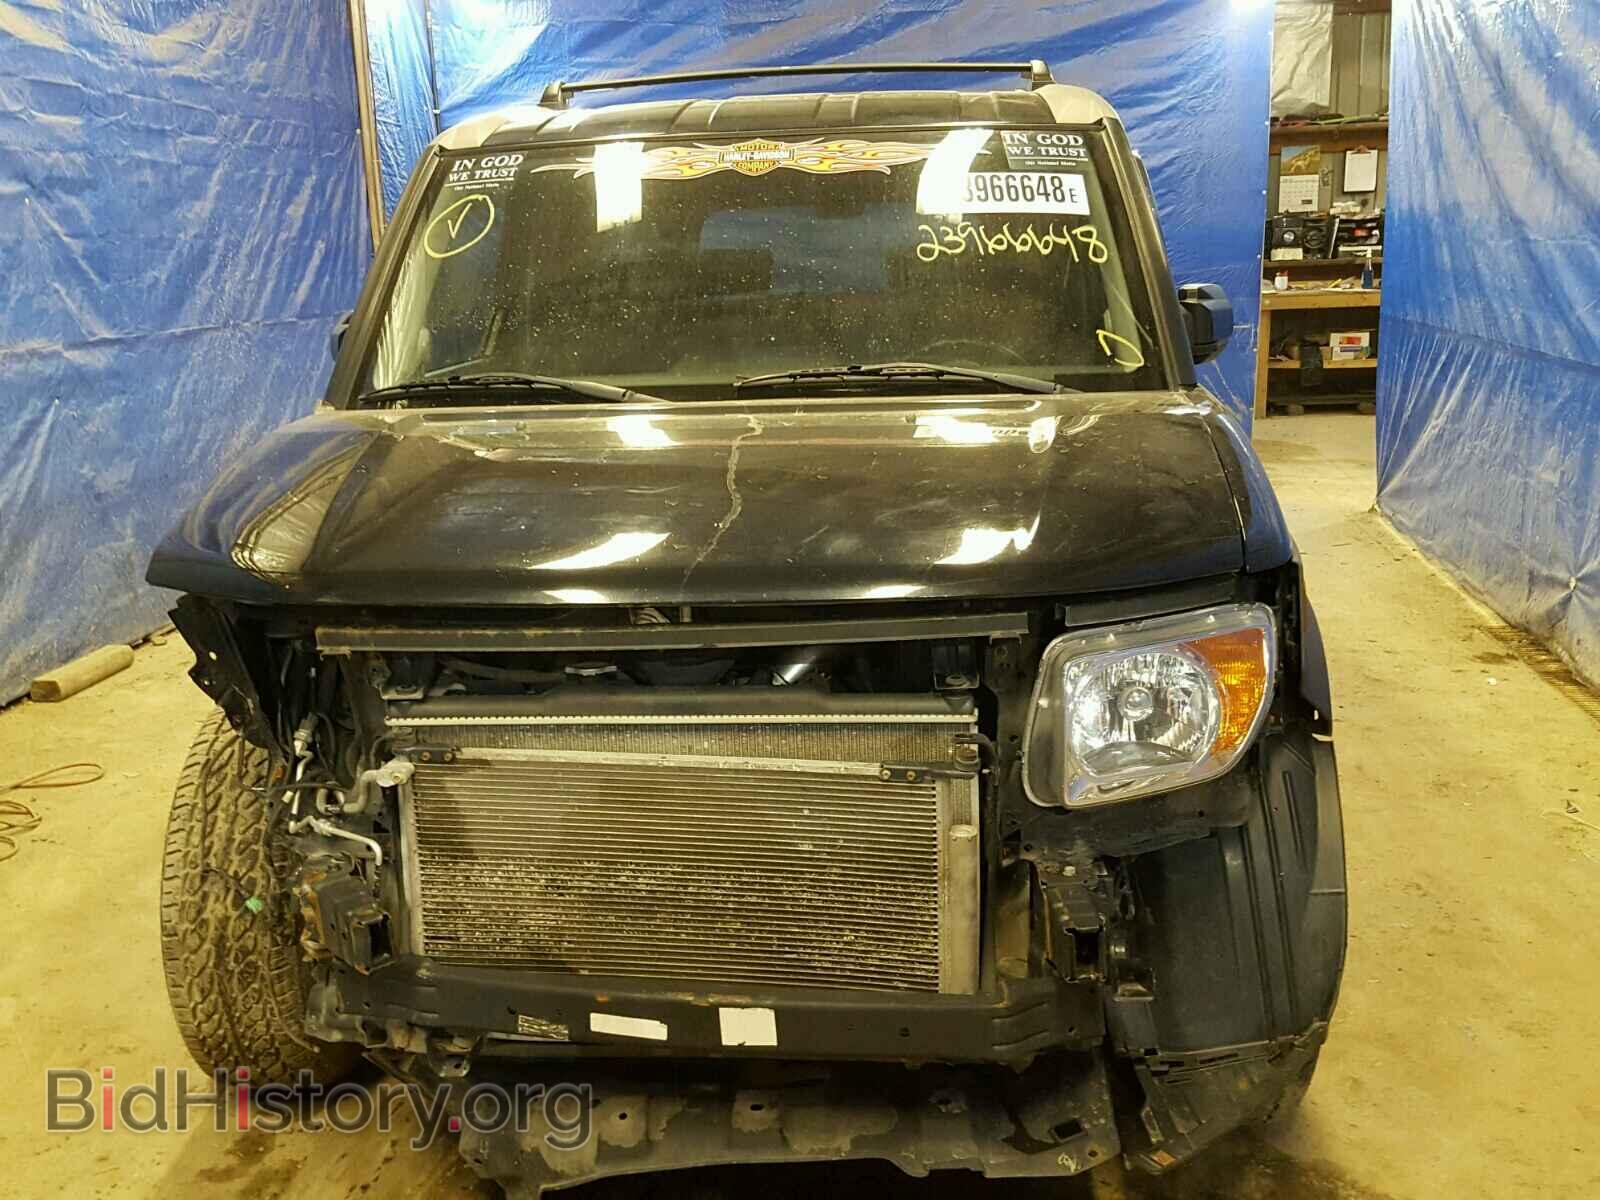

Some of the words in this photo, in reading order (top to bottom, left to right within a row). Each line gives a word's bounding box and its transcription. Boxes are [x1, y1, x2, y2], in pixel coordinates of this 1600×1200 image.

[1004, 134, 1029, 145] IN
[1037, 134, 1083, 146] GOD
[1008, 147, 1034, 156] WE
[1039, 148, 1088, 157] TRUST
[451, 159, 477, 172] IN
[480, 154, 524, 168] GOD
[449, 172, 471, 182] WE
[474, 167, 518, 180] TRUST
[1069, 187, 1078, 203] E
[916, 221, 1108, 263] 23966648
